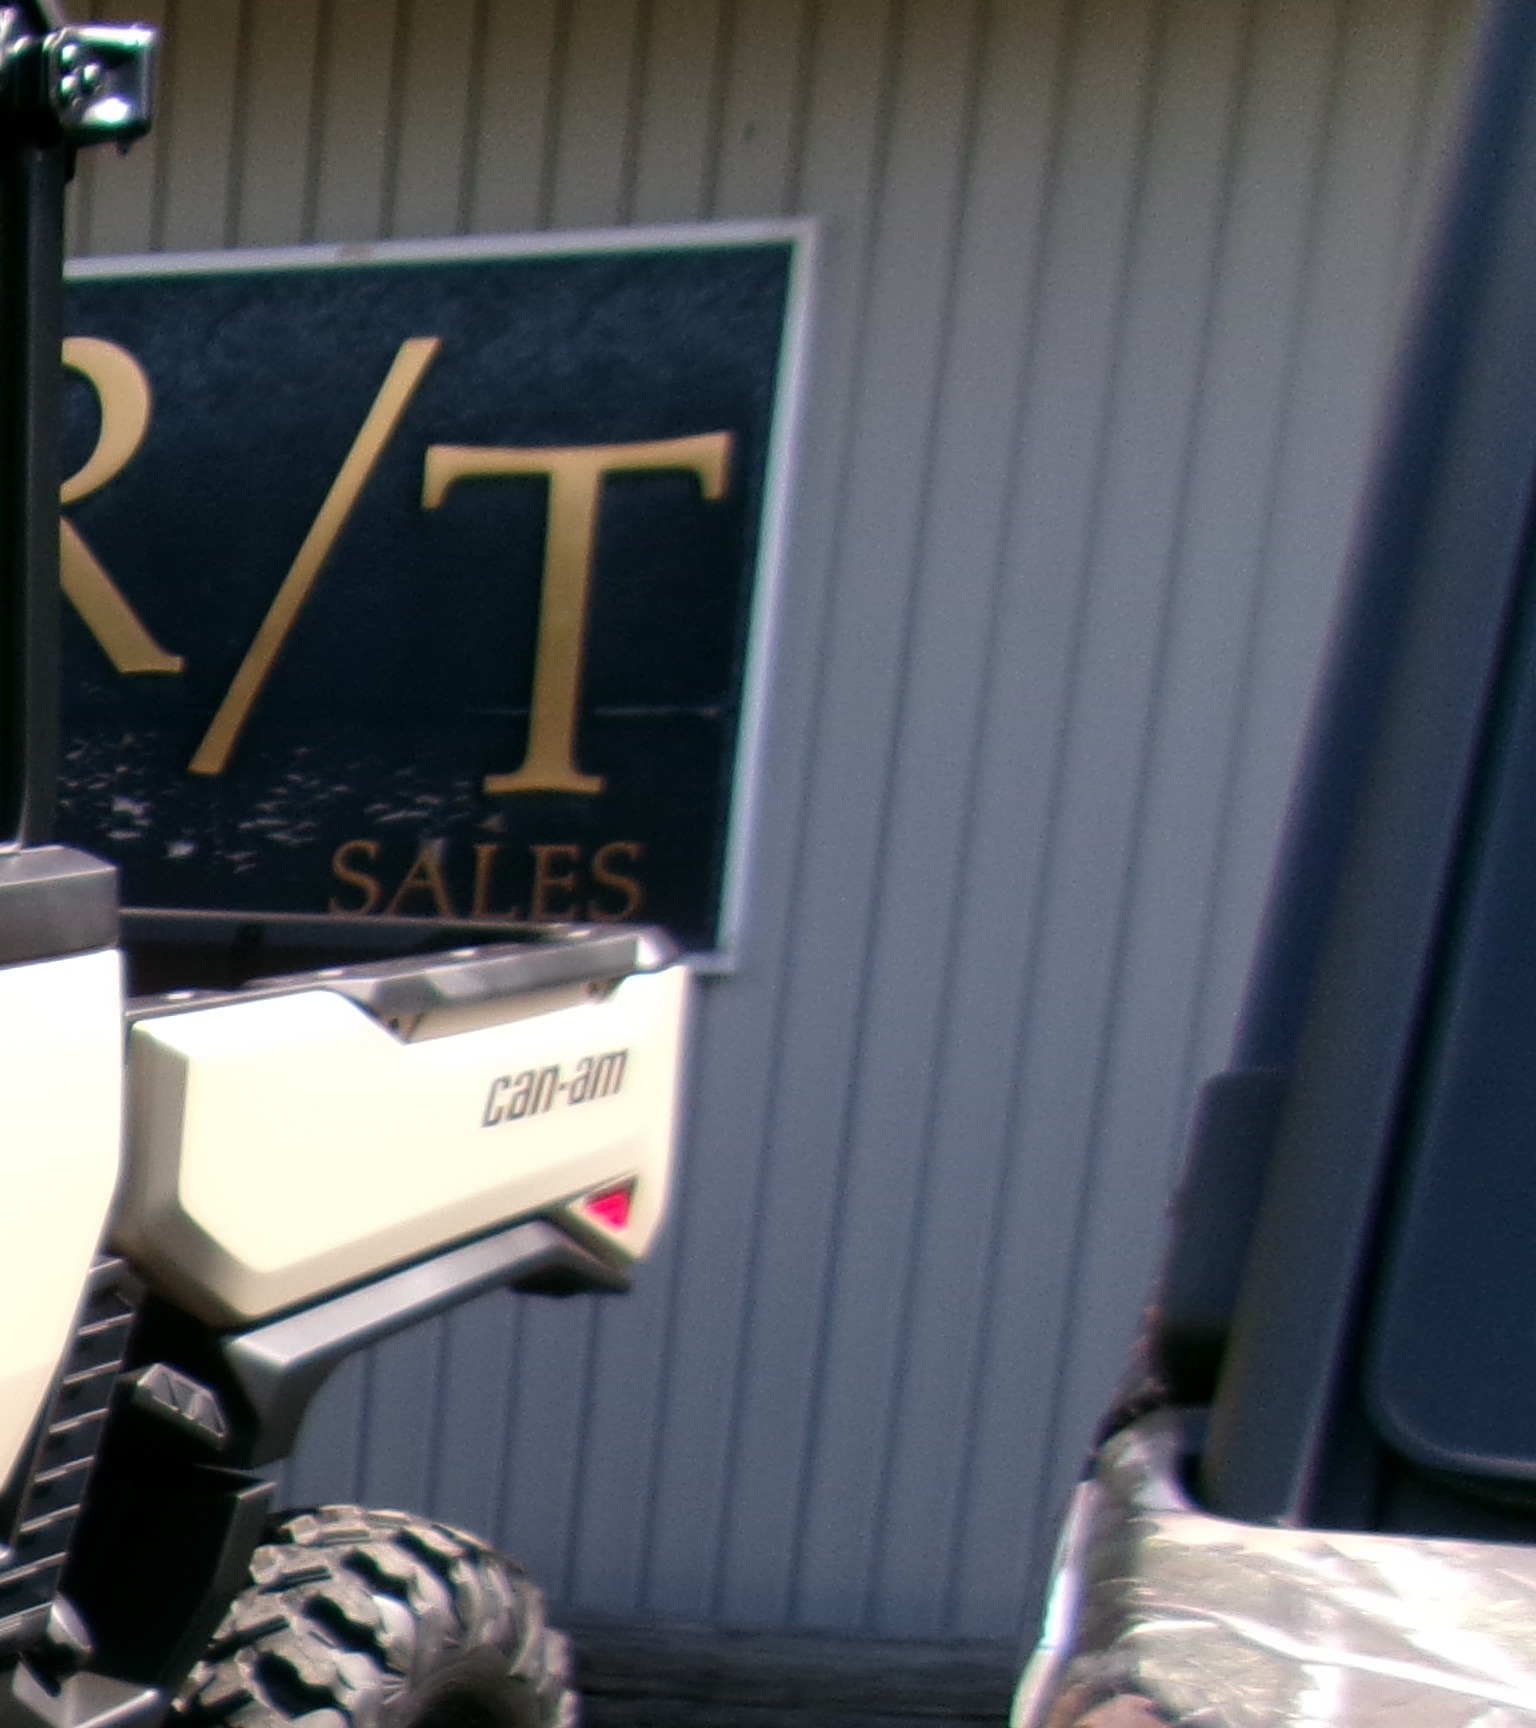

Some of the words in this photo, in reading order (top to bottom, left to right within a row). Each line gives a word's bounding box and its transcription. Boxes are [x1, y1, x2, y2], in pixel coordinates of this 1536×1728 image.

[60, 337, 733, 796] R/T
[328, 839, 646, 924] SALES
[481, 1047, 630, 1128] can-am
